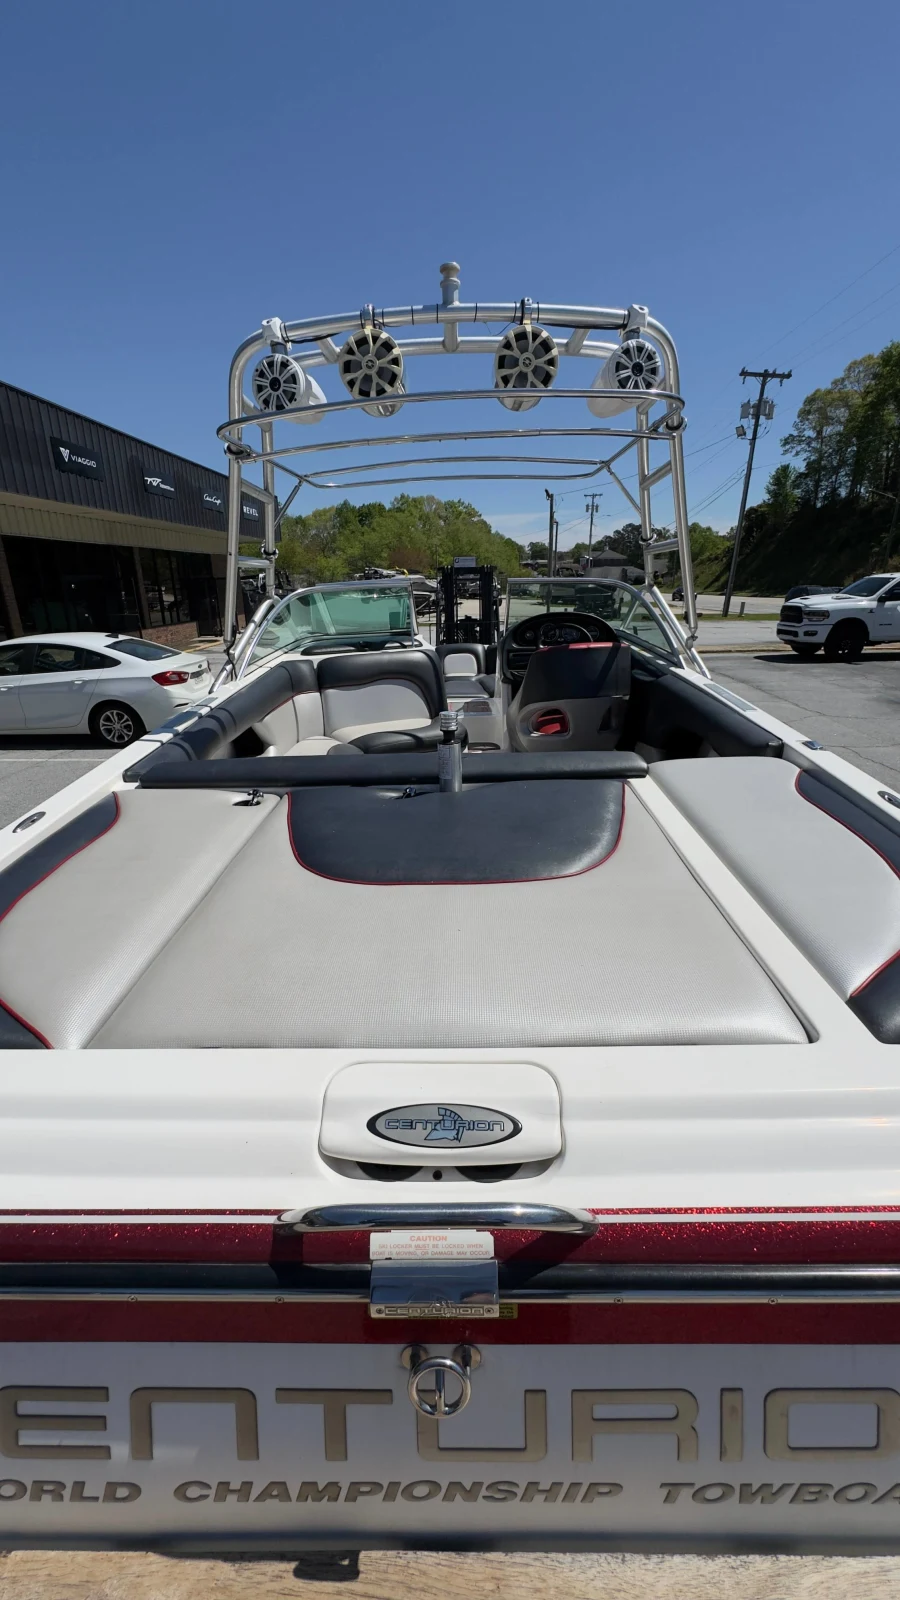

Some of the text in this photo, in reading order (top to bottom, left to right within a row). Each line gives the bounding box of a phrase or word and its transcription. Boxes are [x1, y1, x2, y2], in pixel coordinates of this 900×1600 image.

[70, 454, 97, 468] VIAGGIO
[243, 505, 259, 517] REVEL
[384, 1118, 505, 1132] CENTURION
[385, 1306, 484, 1316] CENTURION
[173, 1480, 623, 1504] CHAMPIONSHIP
